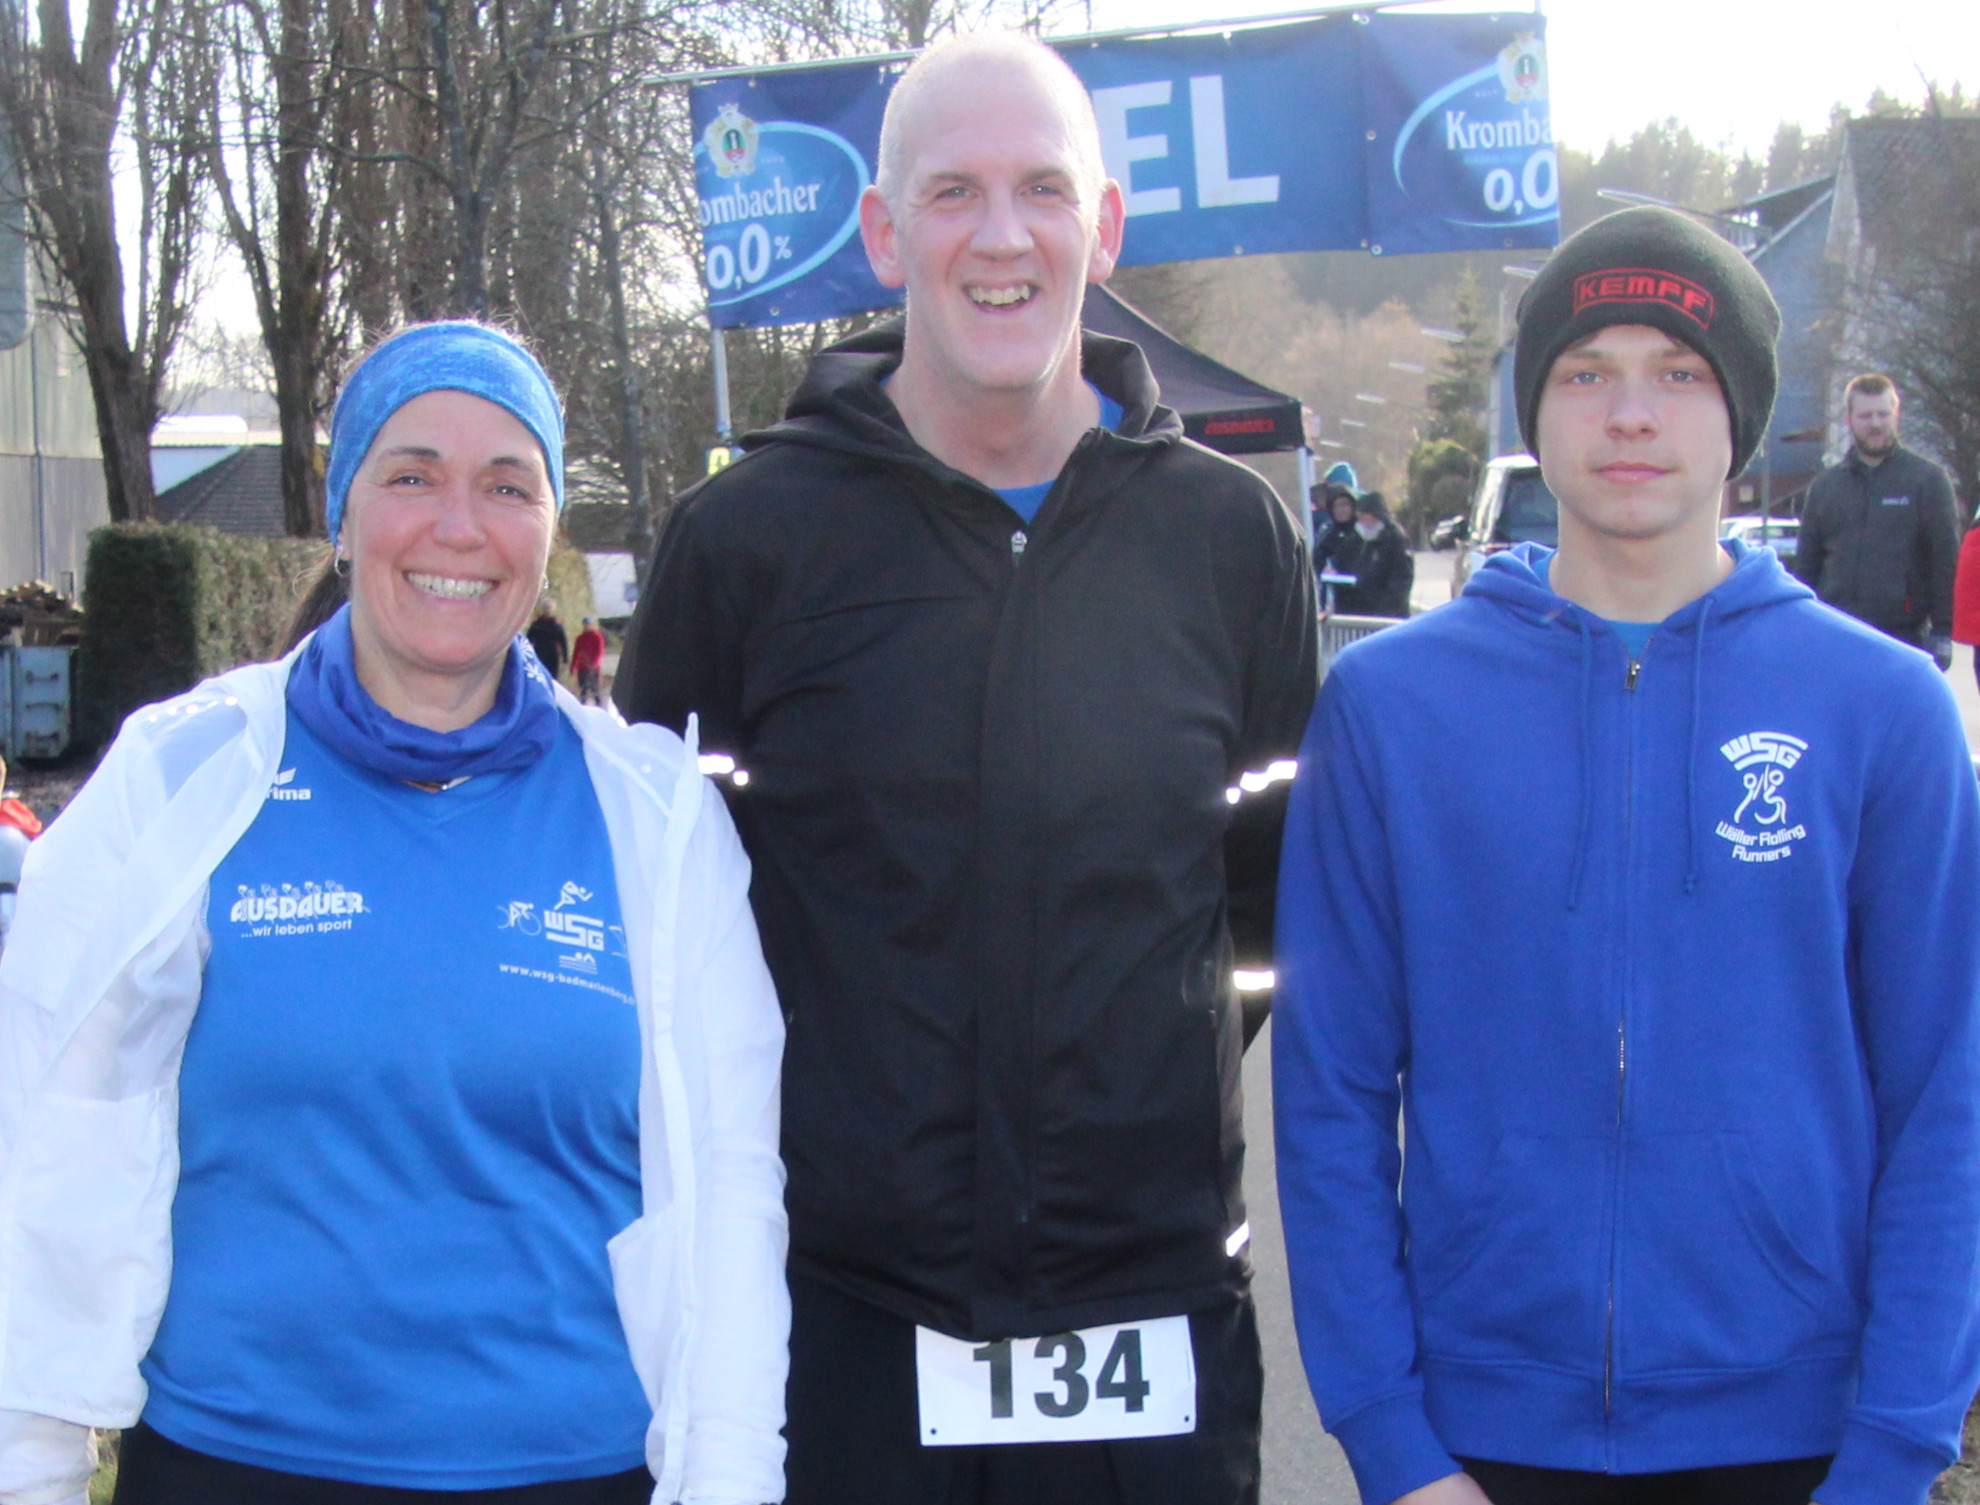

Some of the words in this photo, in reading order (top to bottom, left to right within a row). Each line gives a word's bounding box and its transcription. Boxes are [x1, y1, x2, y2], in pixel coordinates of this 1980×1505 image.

[1092, 75, 1280, 218] EL
[1483, 148, 1559, 215] 0,0
[1580, 275, 1707, 310] KEMPF
[1720, 731, 1808, 771] WSG
[1732, 844, 1791, 862] Runners
[1759, 824, 1807, 847] Rolling
[230, 891, 363, 922] AUSDAUER
[275, 923, 314, 935] leben
[317, 918, 352, 933] sport
[543, 910, 605, 952] WSG
[972, 1329, 1150, 1419] 134
